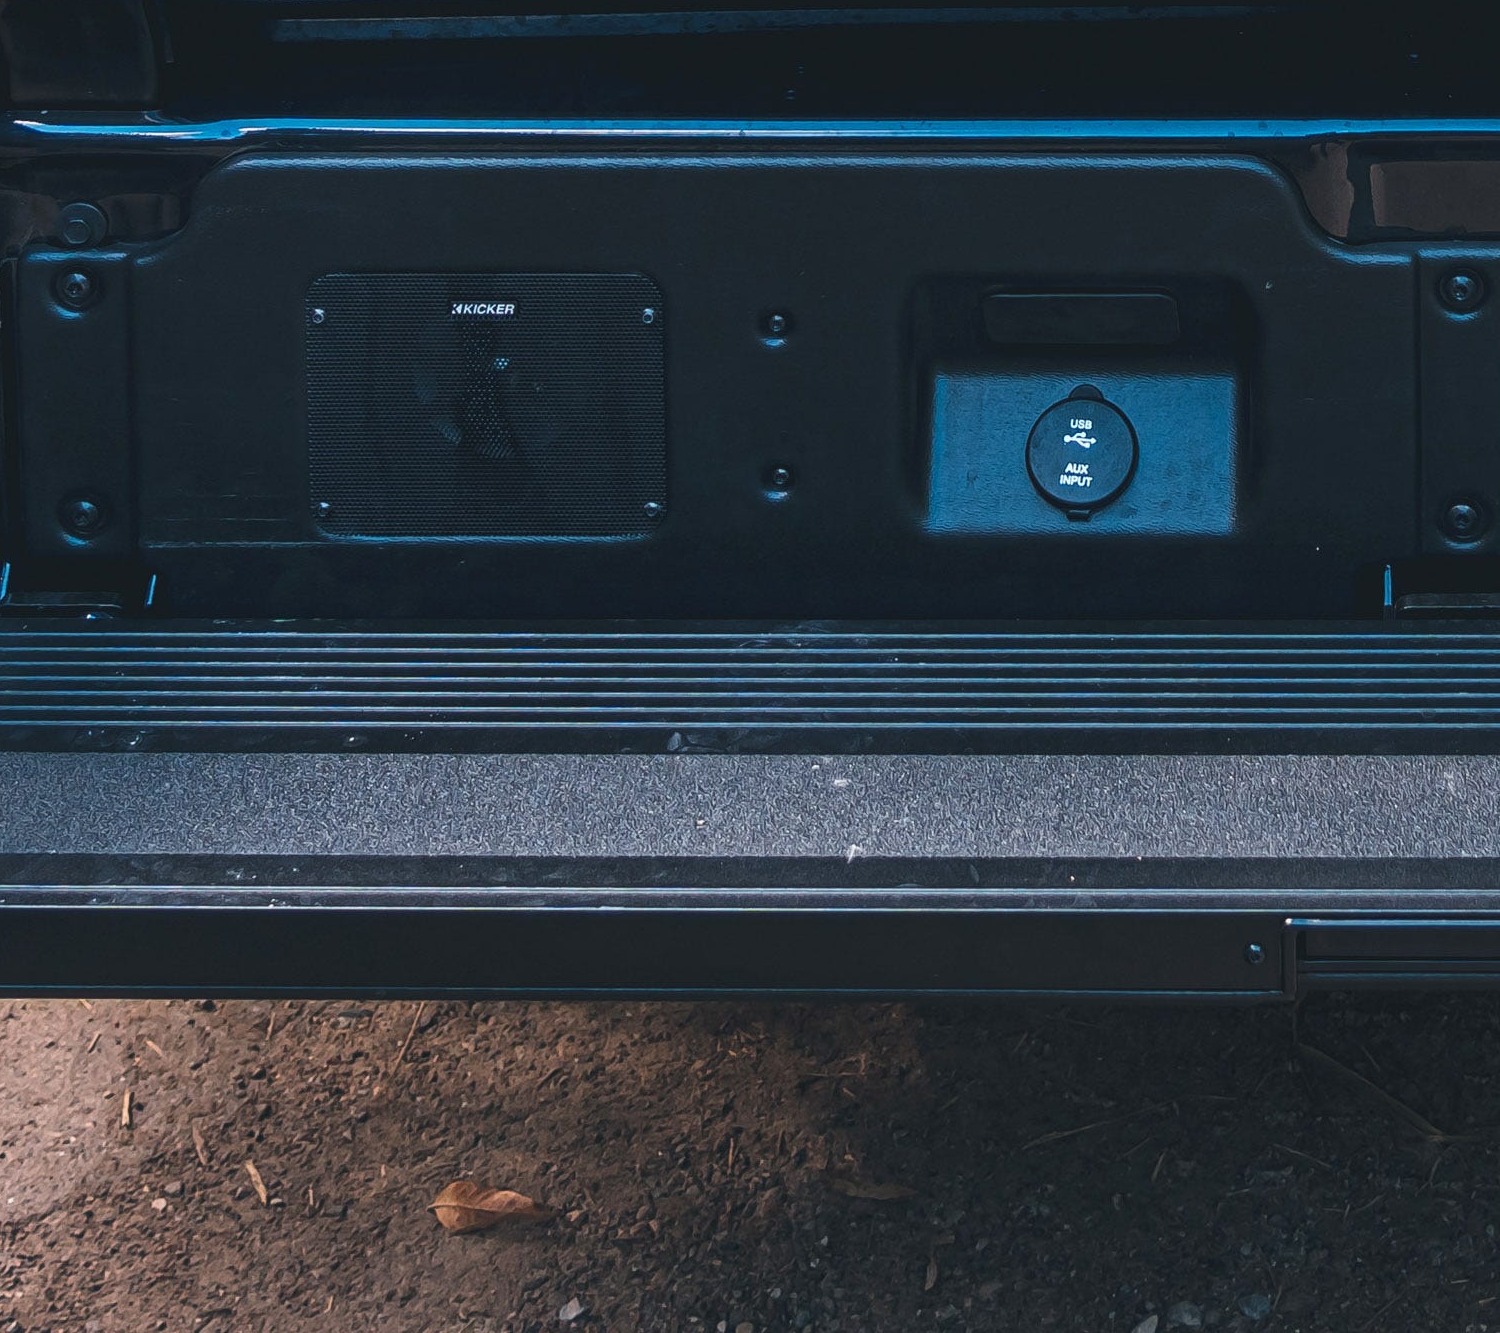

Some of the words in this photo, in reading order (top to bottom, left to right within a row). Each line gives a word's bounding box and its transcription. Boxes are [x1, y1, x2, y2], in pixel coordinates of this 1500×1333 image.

[463, 303, 515, 315] KICKER
[1070, 419, 1093, 430] USB
[1064, 462, 1089, 475] AUX
[1059, 474, 1093, 487] INPUT
